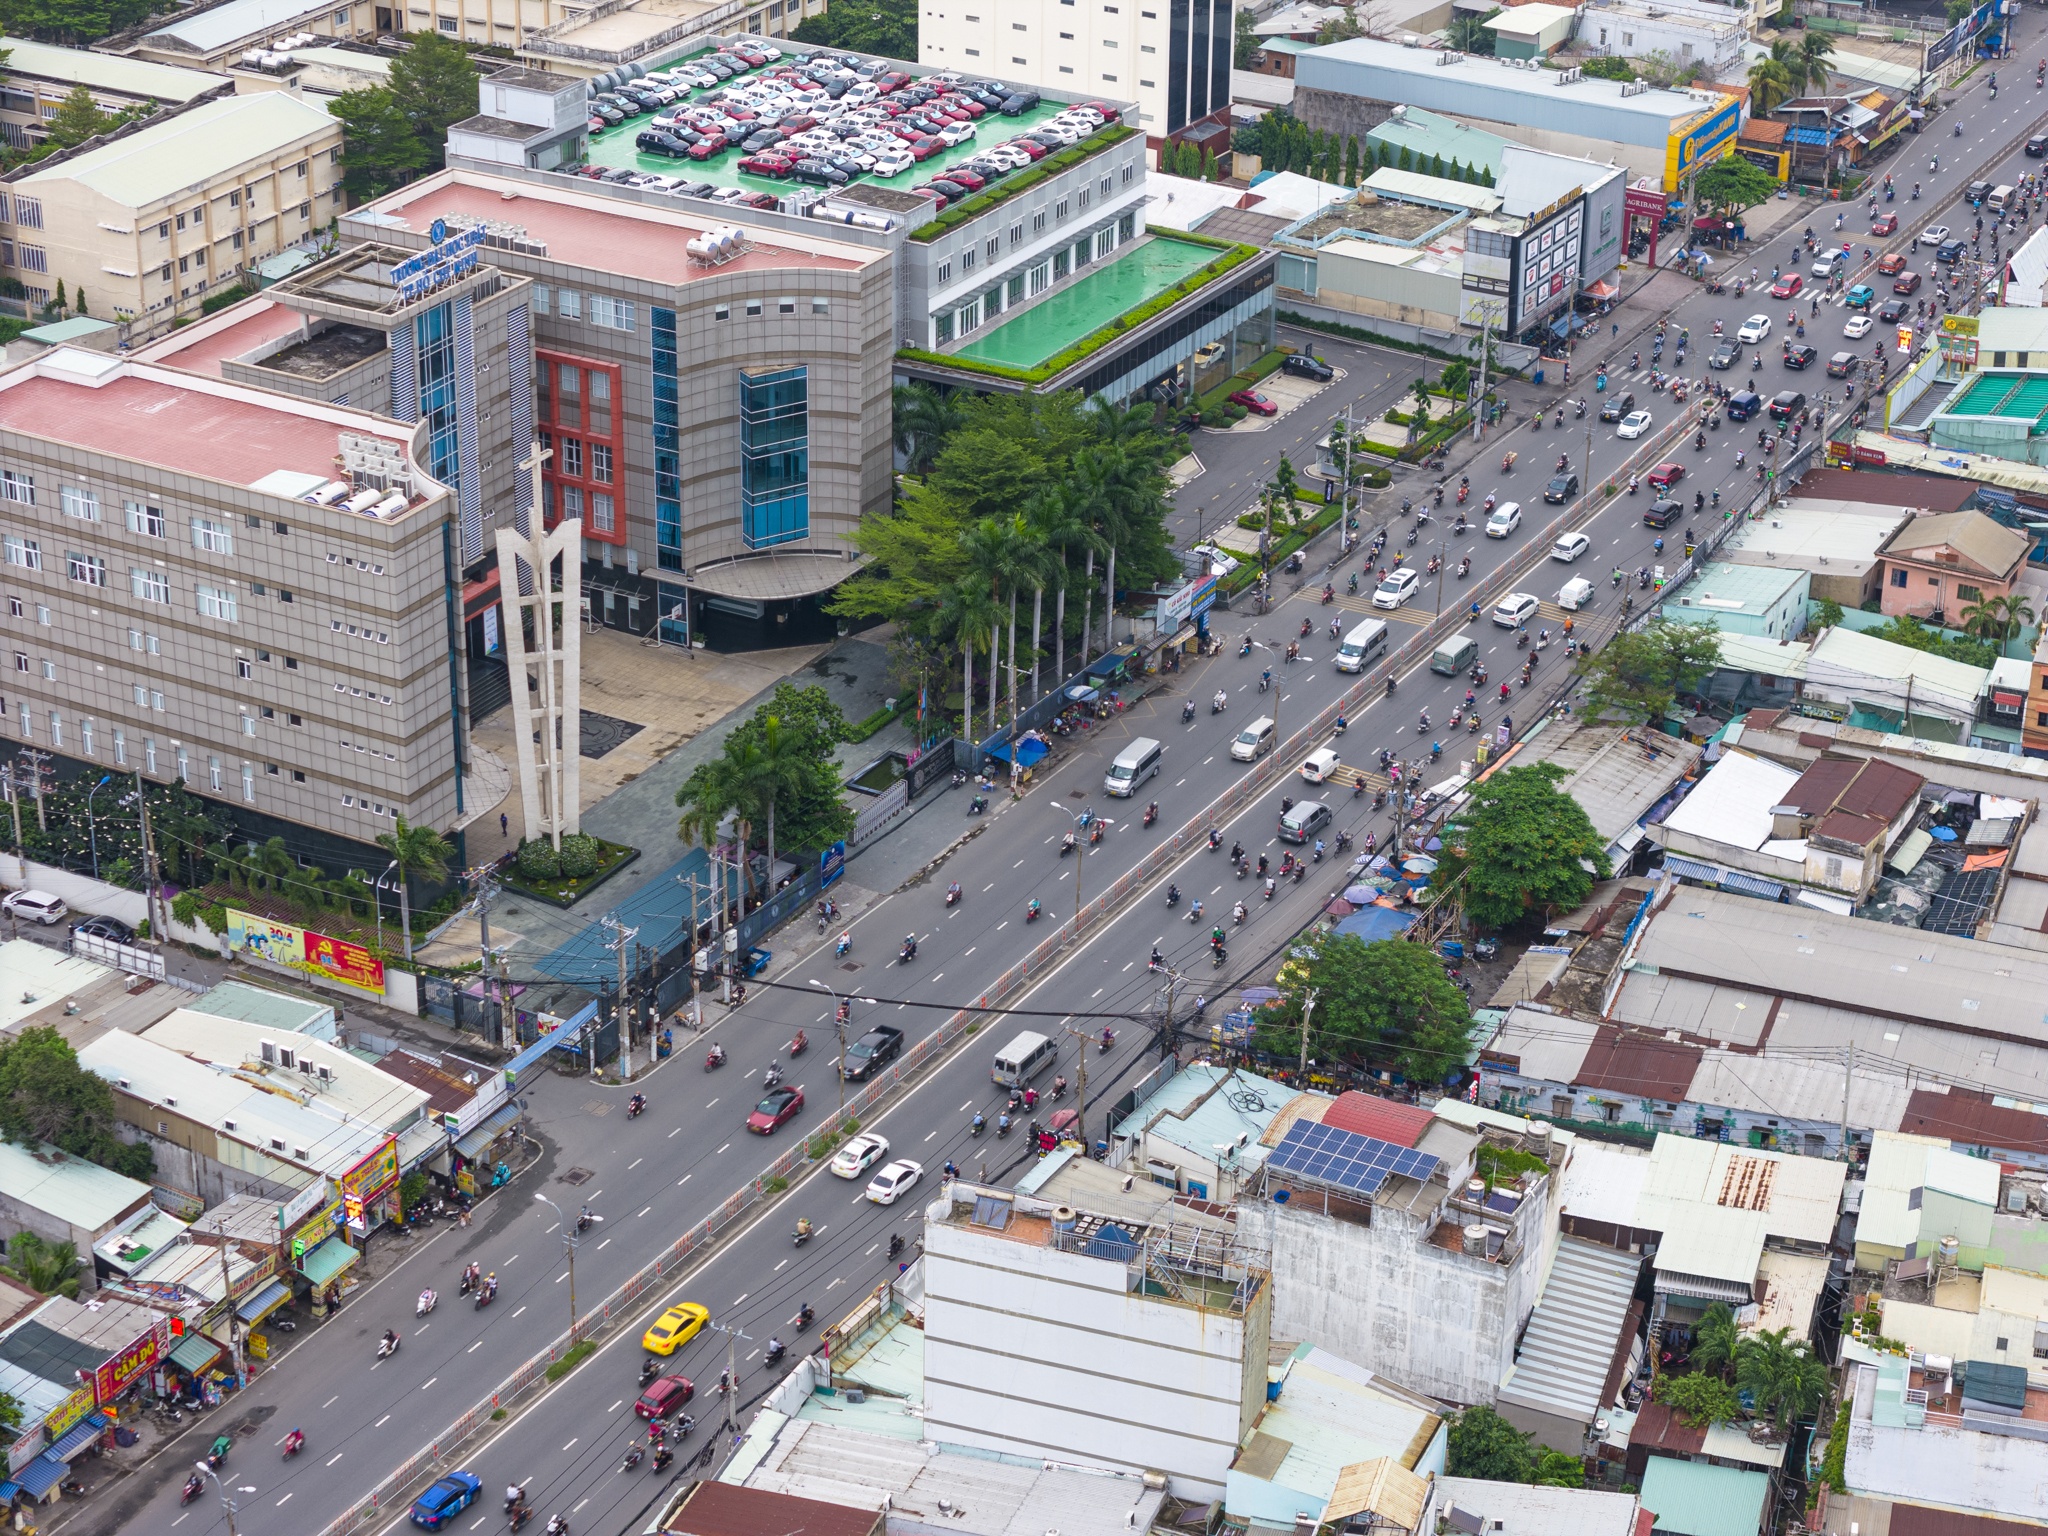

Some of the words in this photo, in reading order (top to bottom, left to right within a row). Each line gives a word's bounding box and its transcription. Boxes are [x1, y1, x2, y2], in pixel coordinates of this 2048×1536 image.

[1627, 199, 1662, 211] AGRIBANK
[269, 927, 294, 945] 30/4
[114, 1355, 138, 1381] CẦM
[140, 1339, 155, 1362] ĐỒ
